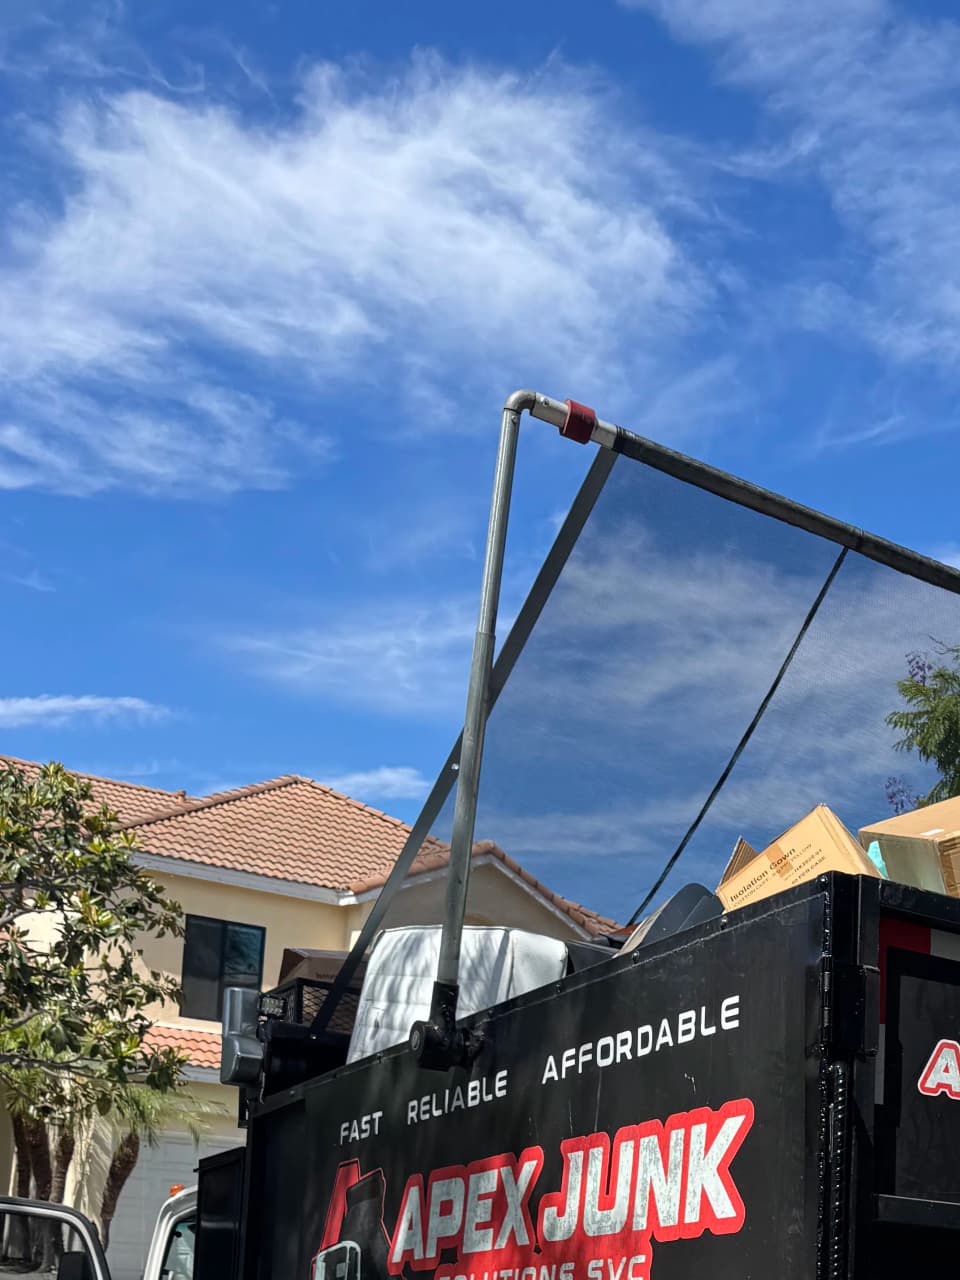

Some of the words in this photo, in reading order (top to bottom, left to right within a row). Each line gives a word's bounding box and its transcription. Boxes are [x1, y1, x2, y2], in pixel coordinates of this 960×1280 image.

[769, 848, 796, 870] Gown
[340, 1111, 383, 1145] FAST
[407, 1070, 508, 1126] RELIABLE
[542, 995, 740, 1084] AFFORDABLE
[392, 1158, 539, 1264] APEX
[542, 1114, 748, 1242] JUNK
